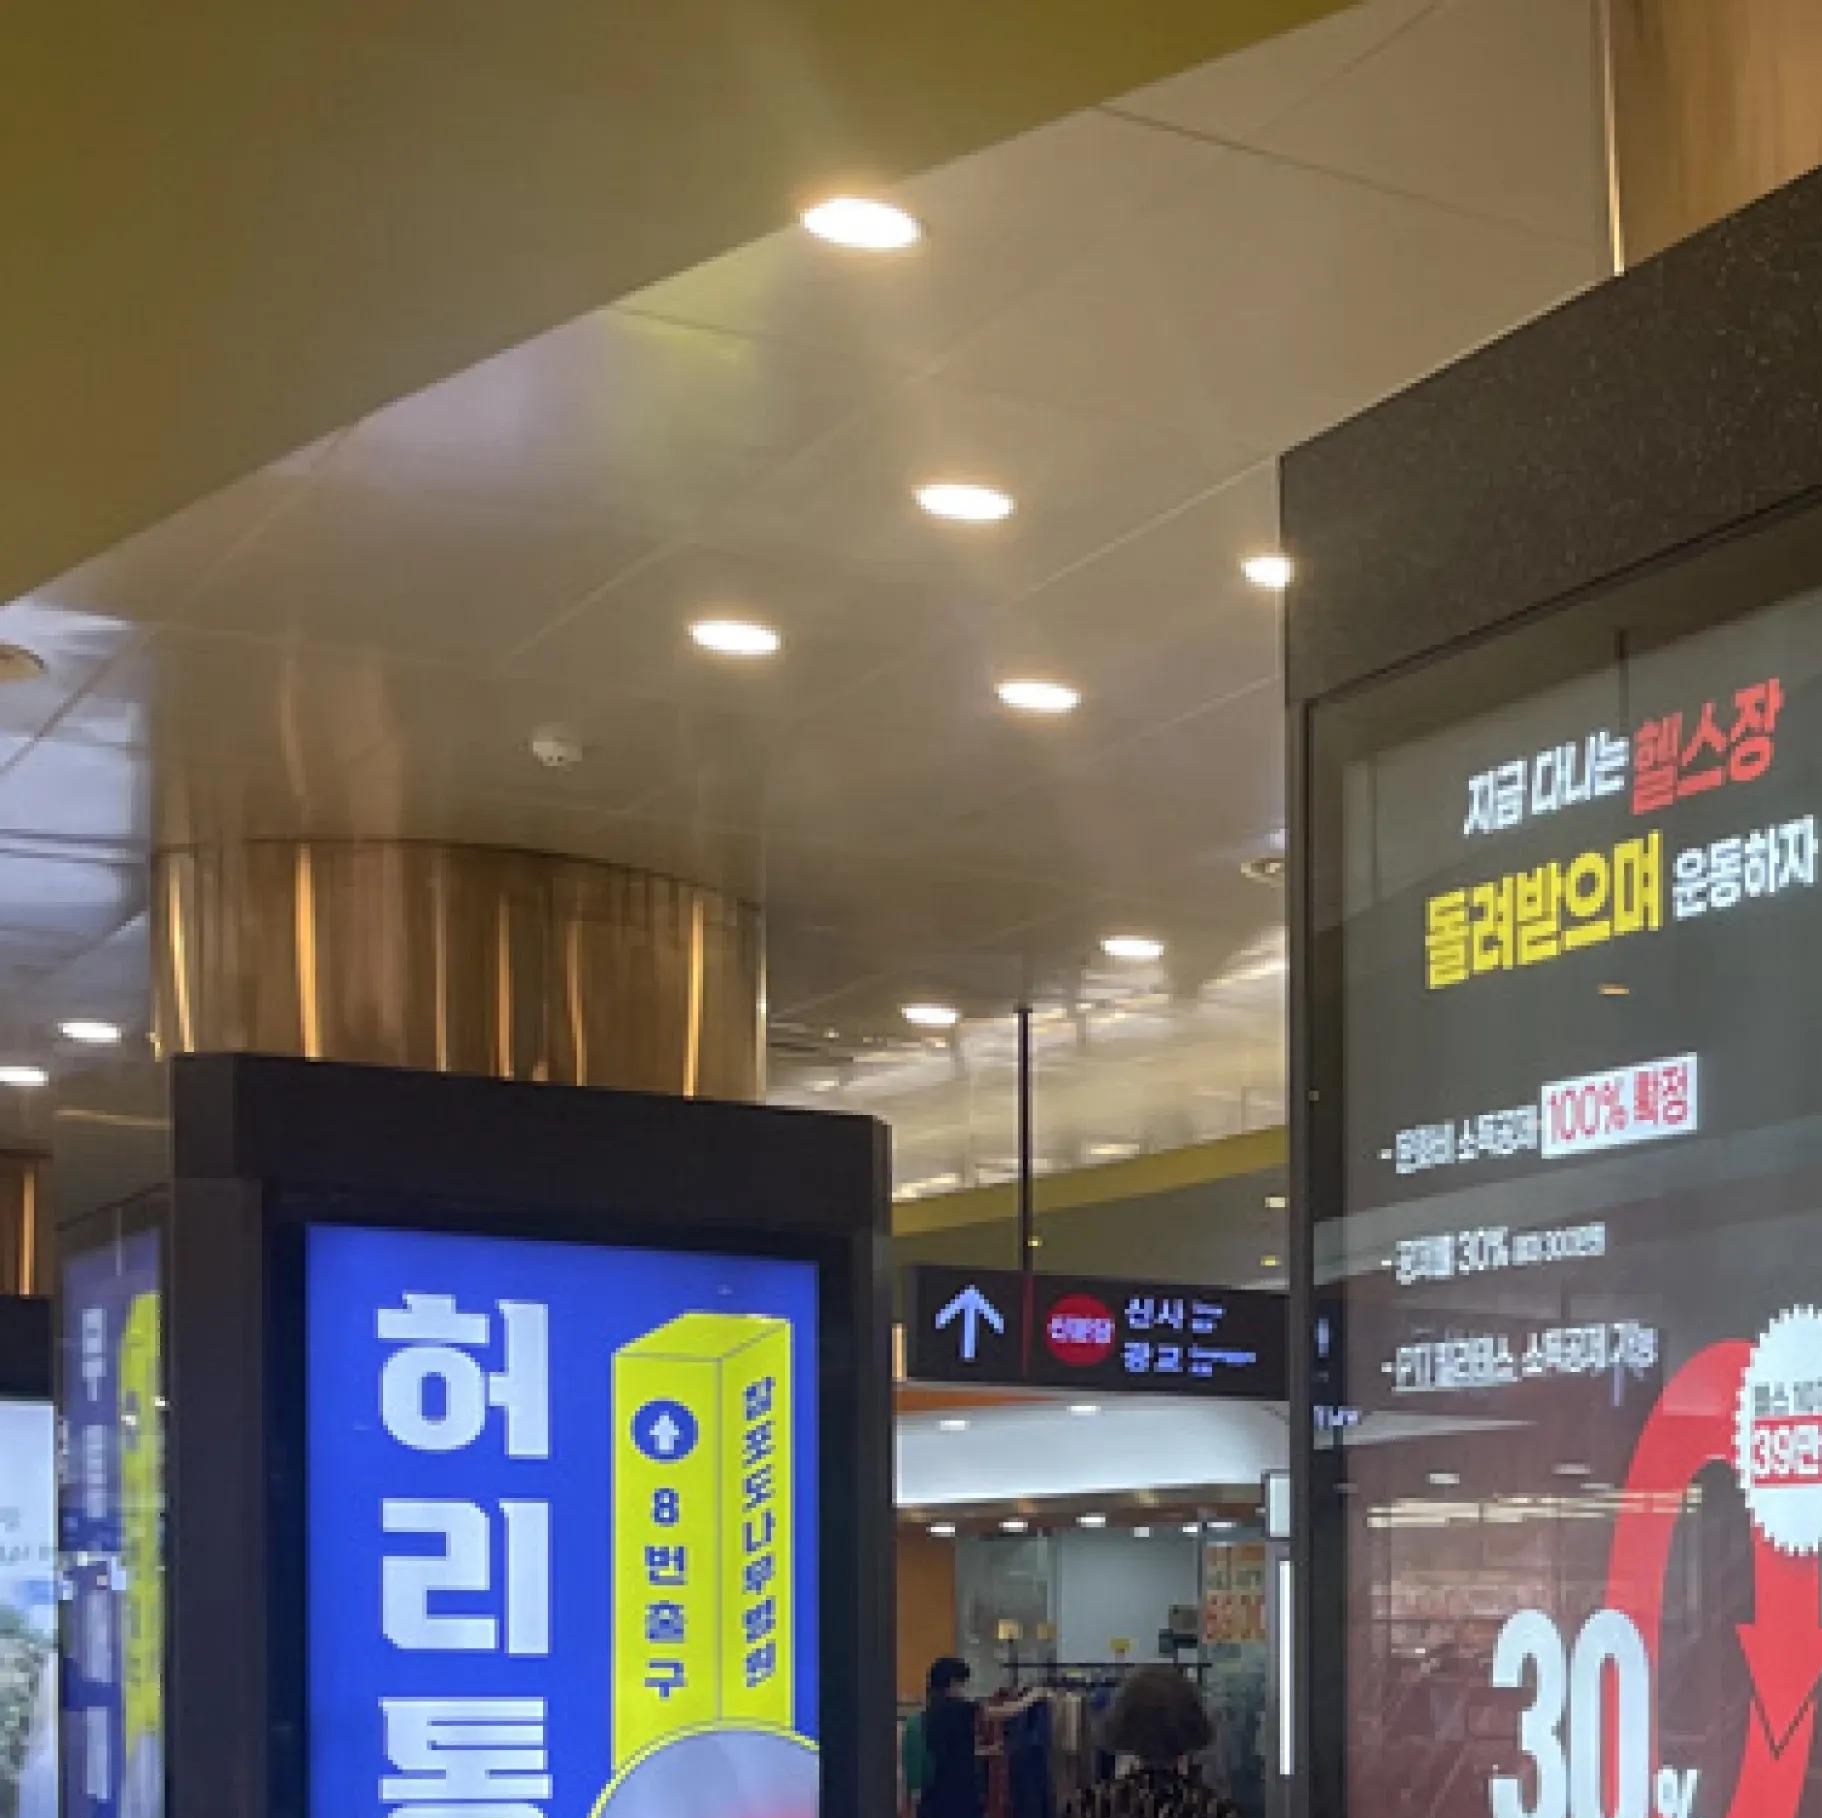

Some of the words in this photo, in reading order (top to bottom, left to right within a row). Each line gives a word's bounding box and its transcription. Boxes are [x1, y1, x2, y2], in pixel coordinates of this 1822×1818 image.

[1464, 760, 1524, 836] 지금
[1531, 731, 1629, 815] 다니는
[1633, 678, 1784, 815] 헬스장
[1425, 830, 1663, 989] 돌려받으며
[1672, 815, 1819, 920] 운동하자
[1550, 1080, 1628, 1145] 100%
[1125, 1296, 1184, 1332] 신사
[1122, 1342, 1184, 1374] 광교
